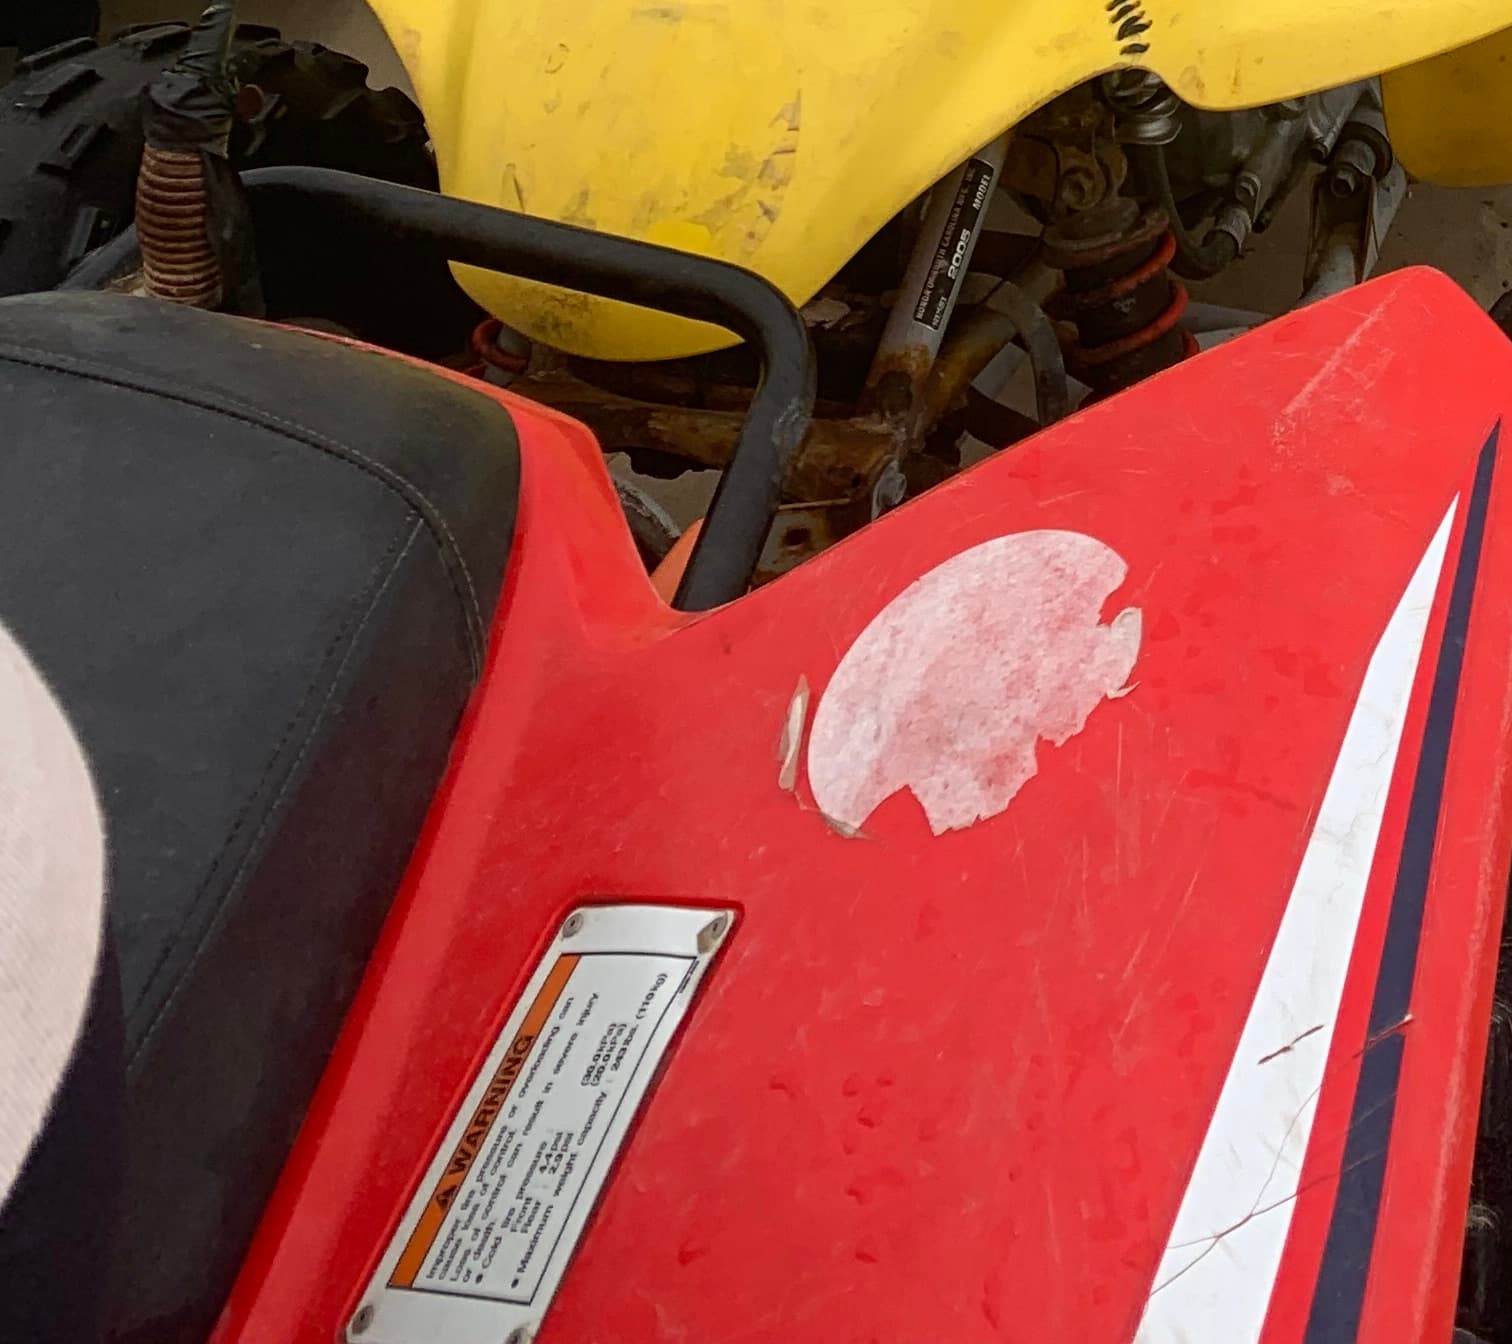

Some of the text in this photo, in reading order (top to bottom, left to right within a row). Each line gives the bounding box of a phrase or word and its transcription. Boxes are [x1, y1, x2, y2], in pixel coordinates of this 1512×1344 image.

[972, 174, 991, 210] MODEL
[947, 228, 971, 280] 2005
[453, 1034, 533, 1176] WARNING
